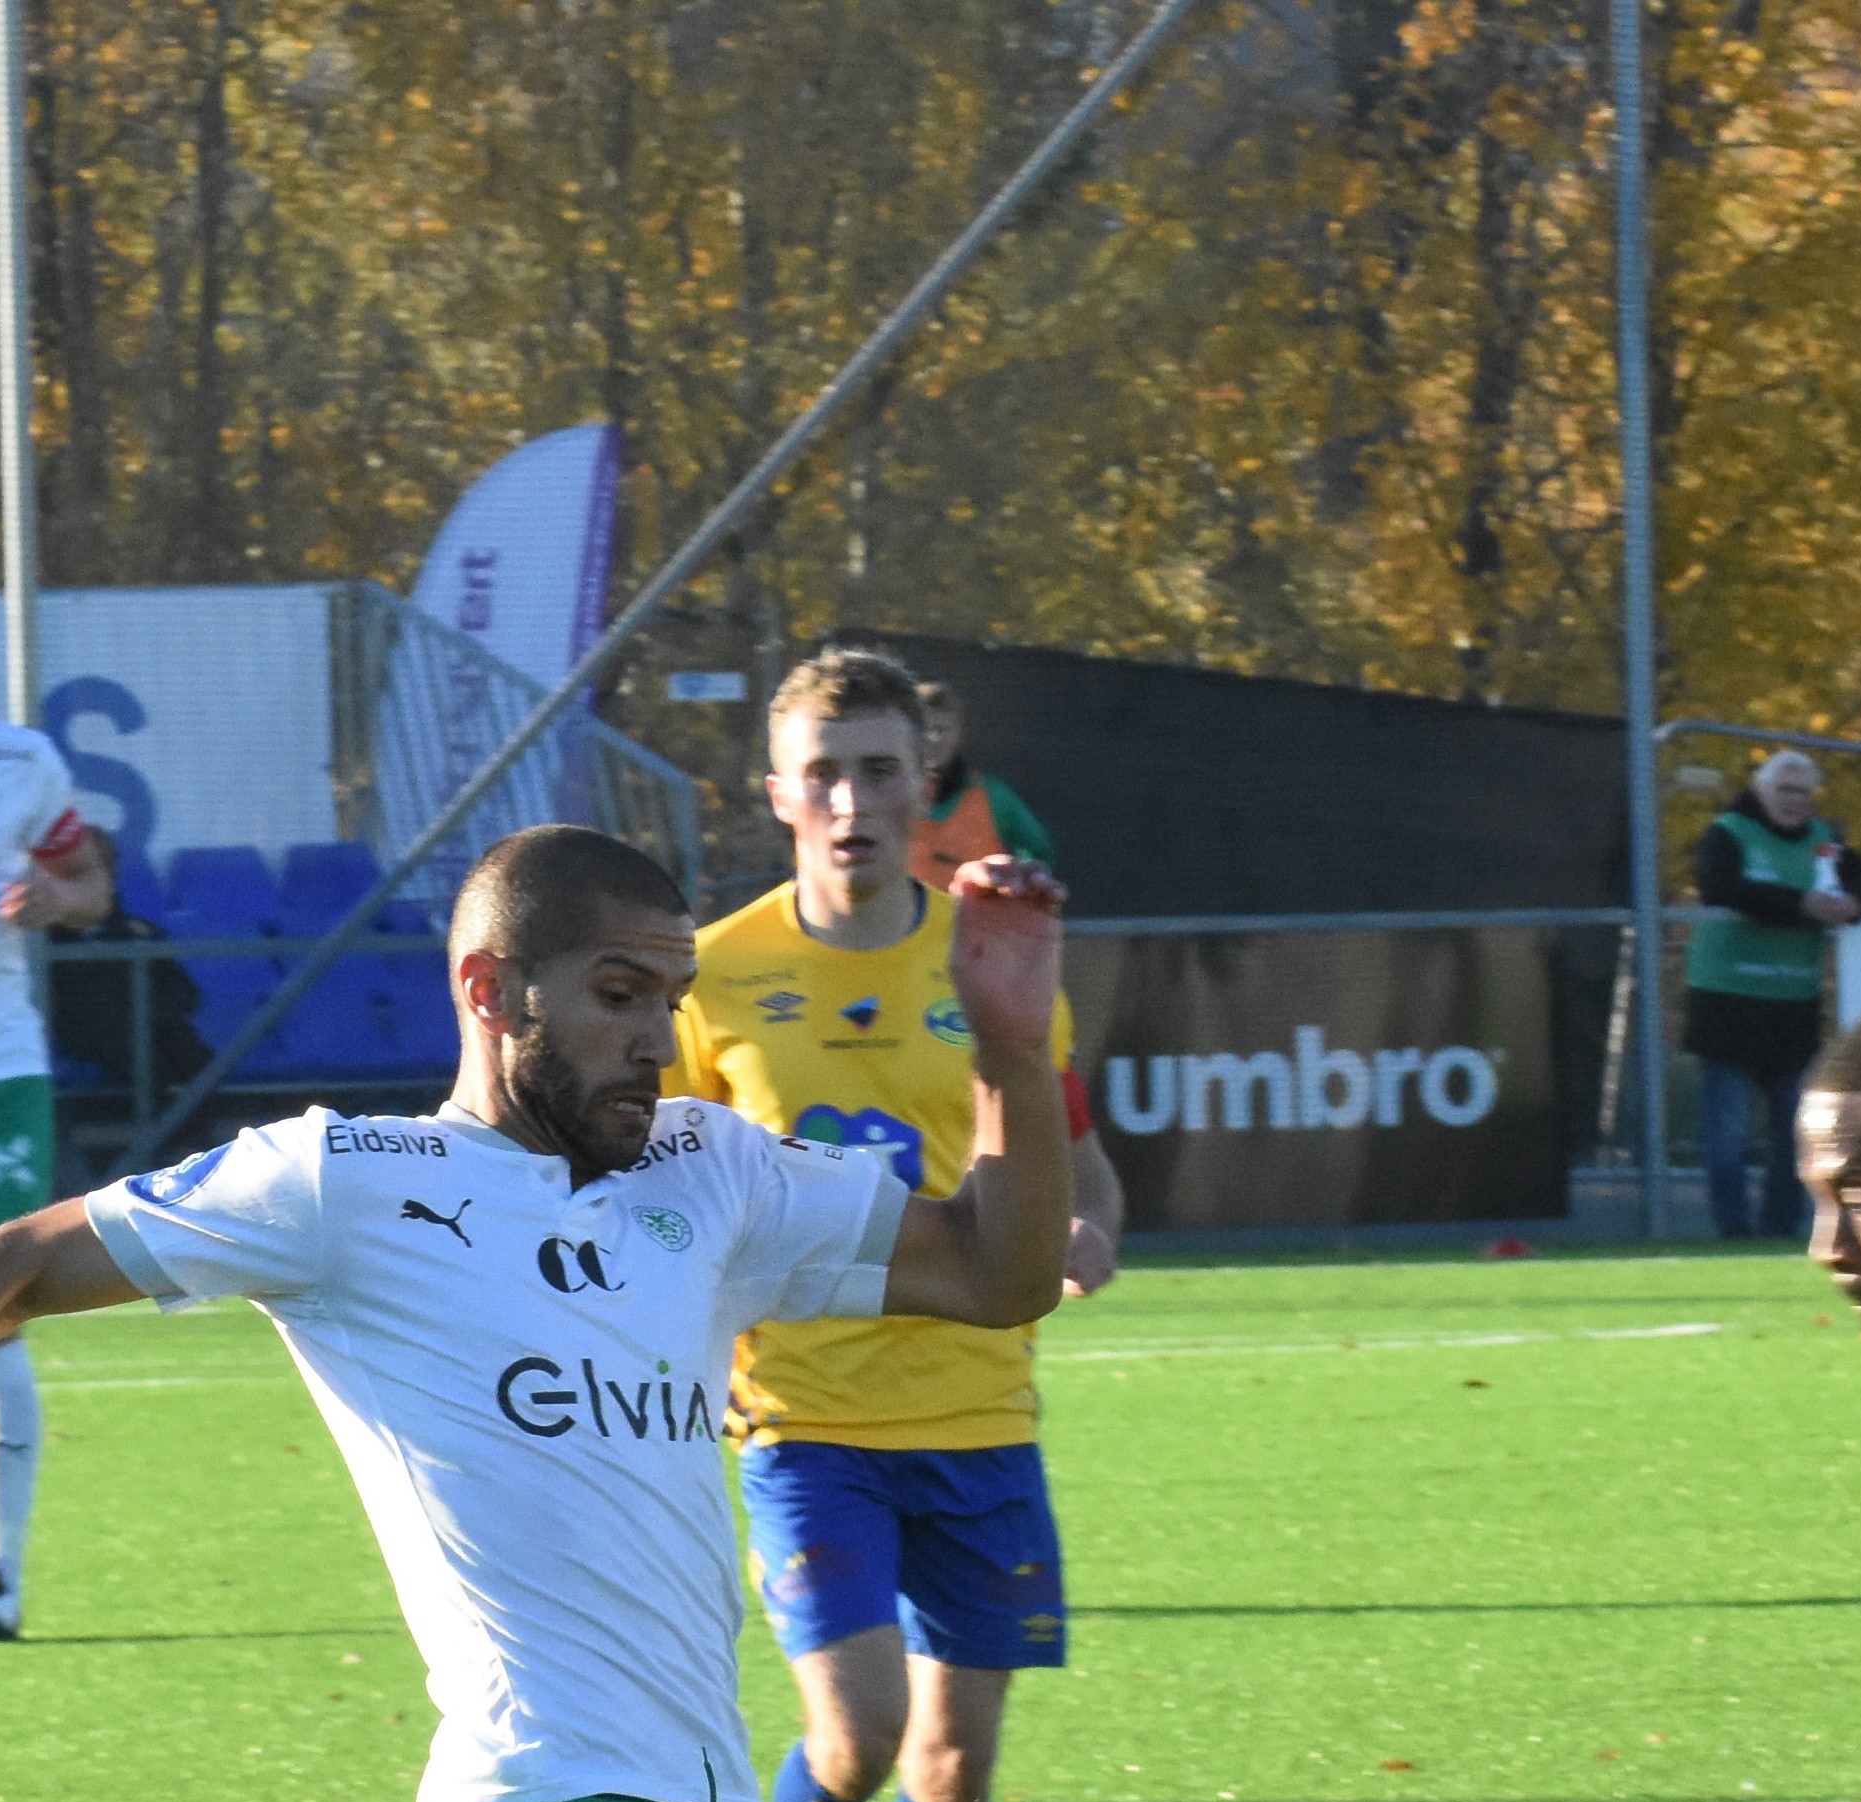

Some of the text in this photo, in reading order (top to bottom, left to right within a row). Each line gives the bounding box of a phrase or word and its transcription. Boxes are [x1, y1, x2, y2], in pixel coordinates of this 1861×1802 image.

[1105, 1024, 1498, 1135] umbro
[324, 1124, 449, 1157] Eidsiva
[624, 1129, 703, 1172] siva
